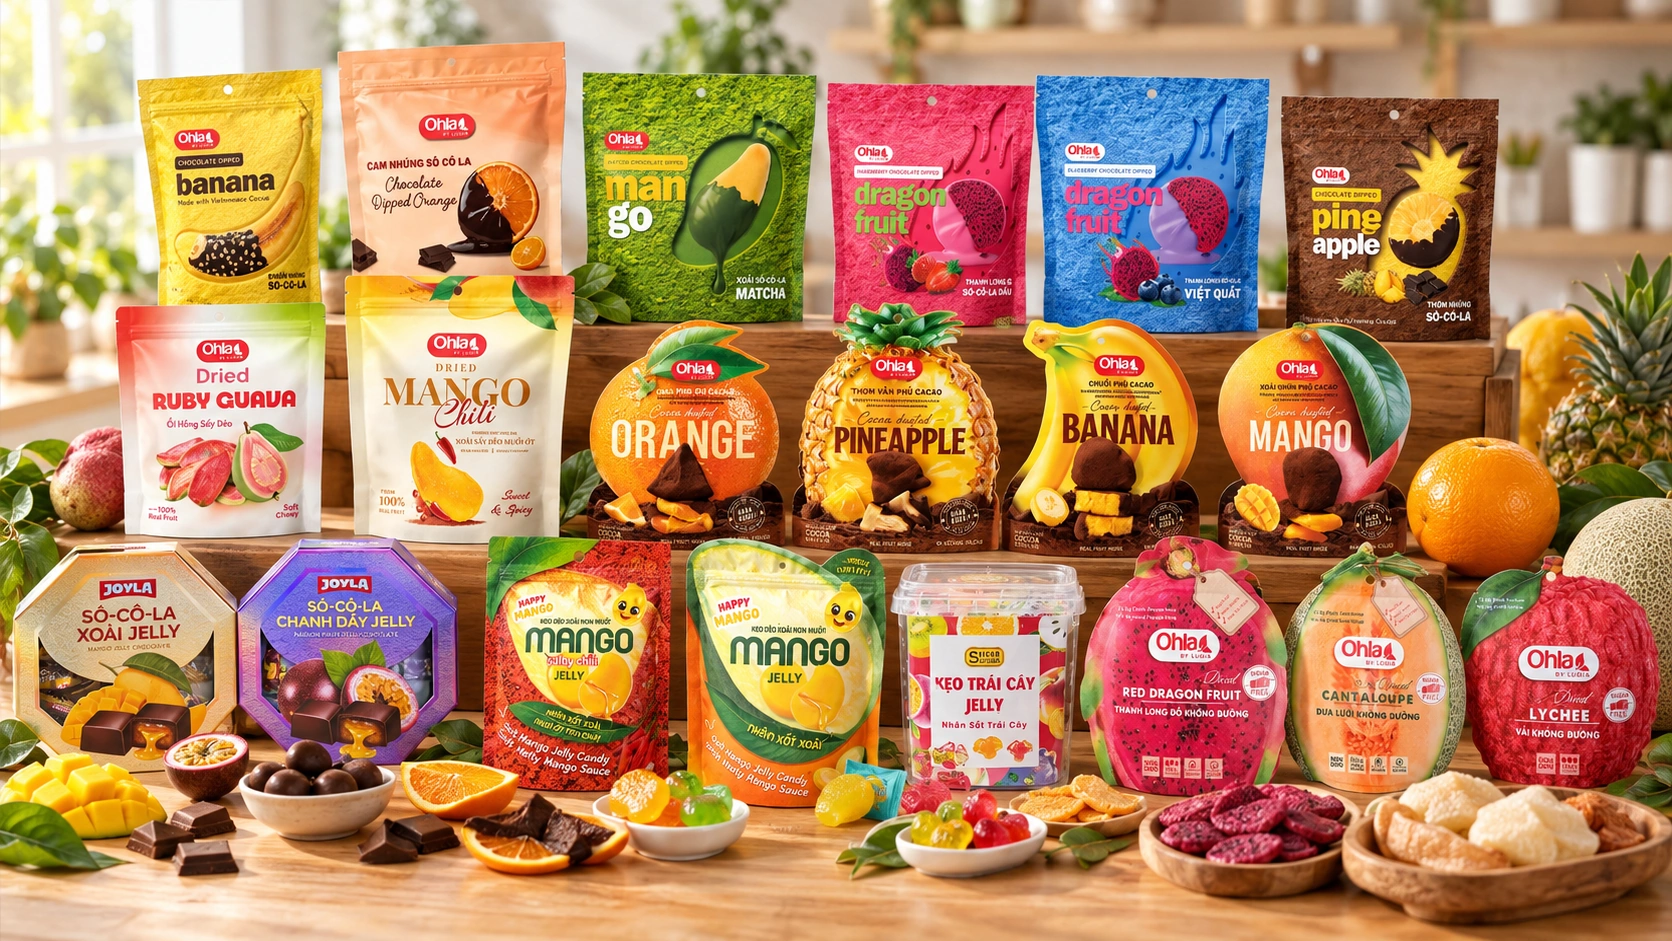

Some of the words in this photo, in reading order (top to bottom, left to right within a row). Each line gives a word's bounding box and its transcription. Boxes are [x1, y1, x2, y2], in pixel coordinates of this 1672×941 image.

[424, 117, 457, 131] Ohla
[178, 132, 205, 144] Ohla
[608, 133, 635, 144] Ohla
[857, 147, 880, 156] Ohla
[1068, 145, 1092, 155] Ohla
[367, 160, 388, 171] CAM
[458, 157, 472, 166] LA
[1315, 169, 1338, 178] Ohla
[176, 173, 275, 196] banana
[385, 175, 443, 193] Chocolate
[605, 175, 686, 202] man
[371, 193, 411, 214] Dipped
[412, 192, 458, 211] Orange
[855, 181, 947, 211] dragon
[1065, 179, 1163, 211] dragon
[607, 201, 653, 239] go
[854, 208, 909, 234] fruit
[1065, 207, 1122, 234] fruit
[1313, 233, 1380, 260] apple
[736, 287, 786, 300] MATCHA
[202, 342, 232, 355] Ohla
[433, 336, 468, 349] Ohla
[435, 363, 477, 373] DRIED
[676, 362, 706, 374] Ohla
[876, 359, 905, 372] Ohla
[1099, 357, 1129, 369] Ohla
[1281, 362, 1309, 375] Ohla
[196, 367, 249, 384] Dried
[153, 392, 210, 410] RUBY
[216, 390, 296, 409] GUAVA
[383, 377, 531, 408] MANGO
[915, 388, 942, 396] CACAO
[434, 398, 496, 429] Chili
[1062, 413, 1175, 445] BANANA
[1250, 419, 1352, 453] MANGO
[611, 419, 755, 460] ORANGE
[834, 426, 966, 455] PINEAPPLE
[283, 503, 299, 511] Soft
[379, 496, 405, 507] 100%
[103, 582, 153, 596] JOYLA
[321, 578, 369, 590] JOYLA
[518, 594, 546, 608] HAPPY
[718, 597, 750, 613] HAPPY
[81, 603, 176, 624] SÔ-CÔ-LA
[514, 603, 554, 621] MANGO
[713, 608, 760, 628] MANGO
[276, 615, 333, 628] CHANH
[371, 615, 416, 628] JELLY
[77, 623, 122, 643] XOÀI
[128, 623, 181, 641] JELLY
[525, 627, 634, 654] MANGO
[1156, 632, 1197, 651] Ohla
[730, 635, 850, 667] MANGO
[1341, 639, 1382, 658] Ohla
[1527, 649, 1573, 670] Ohla
[553, 670, 585, 681] JELLY
[767, 672, 802, 684] JELLY
[935, 676, 964, 693] KẸO
[967, 674, 1001, 691] TRÁI
[1122, 686, 1145, 698] RED
[1150, 687, 1203, 700] DRAGON
[1207, 689, 1241, 700] FRUIT
[1321, 690, 1414, 705] CANTALOUPE
[964, 698, 1004, 715] JELLY
[1114, 705, 1143, 715] THANH
[1145, 707, 1168, 716] LONG
[1529, 707, 1590, 722] LYCHEE
[987, 720, 1006, 729] Trái
[518, 733, 549, 753] Mango
[576, 751, 610, 766] Candy
[543, 757, 577, 774] Mango
[579, 765, 611, 777] Sauce
[753, 763, 774, 780] Jelly
[776, 772, 808, 787] Candy
[779, 784, 809, 797] Sauce
